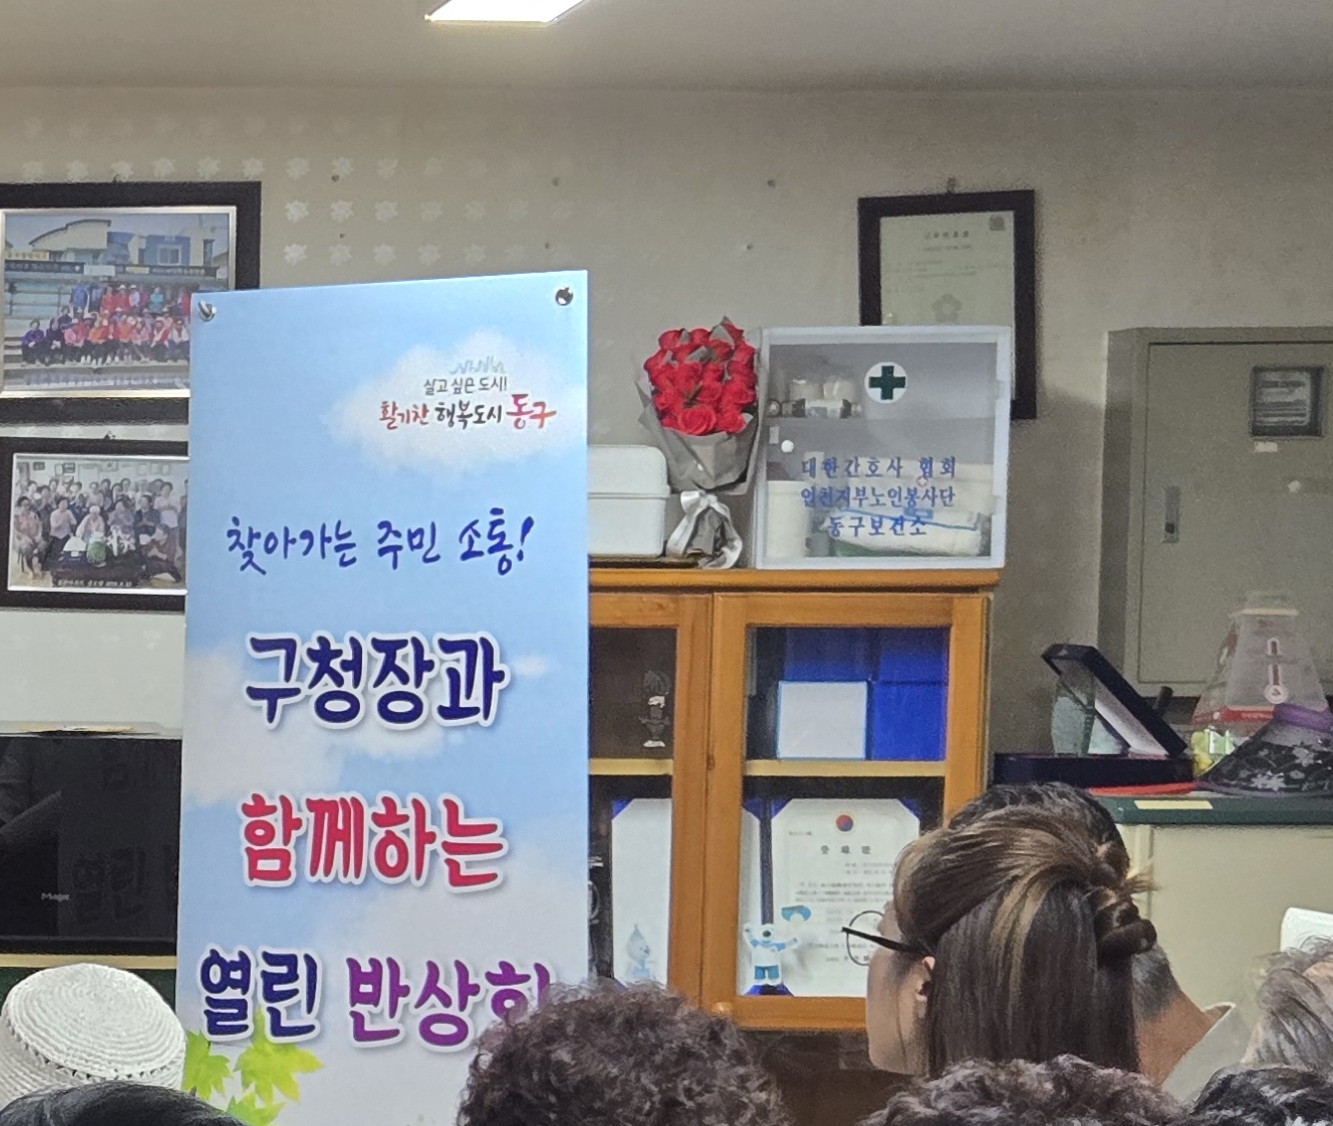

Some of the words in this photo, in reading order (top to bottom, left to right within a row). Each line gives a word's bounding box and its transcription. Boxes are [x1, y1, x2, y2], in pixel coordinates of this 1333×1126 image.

[379, 400, 430, 430] 활기찬
[434, 400, 502, 430] 행복도시
[506, 393, 557, 430] 동구
[423, 377, 448, 396] 살고
[451, 377, 475, 395] 싶은
[478, 376, 508, 392] 도시!
[801, 456, 903, 479] 대한간호사
[227, 516, 357, 576] 찾아가는
[377, 519, 440, 571] 주민
[459, 507, 534, 576] 소통!
[246, 636, 505, 724] 구청장과
[241, 793, 504, 888] 함께하는
[199, 948, 318, 1038] 열린
